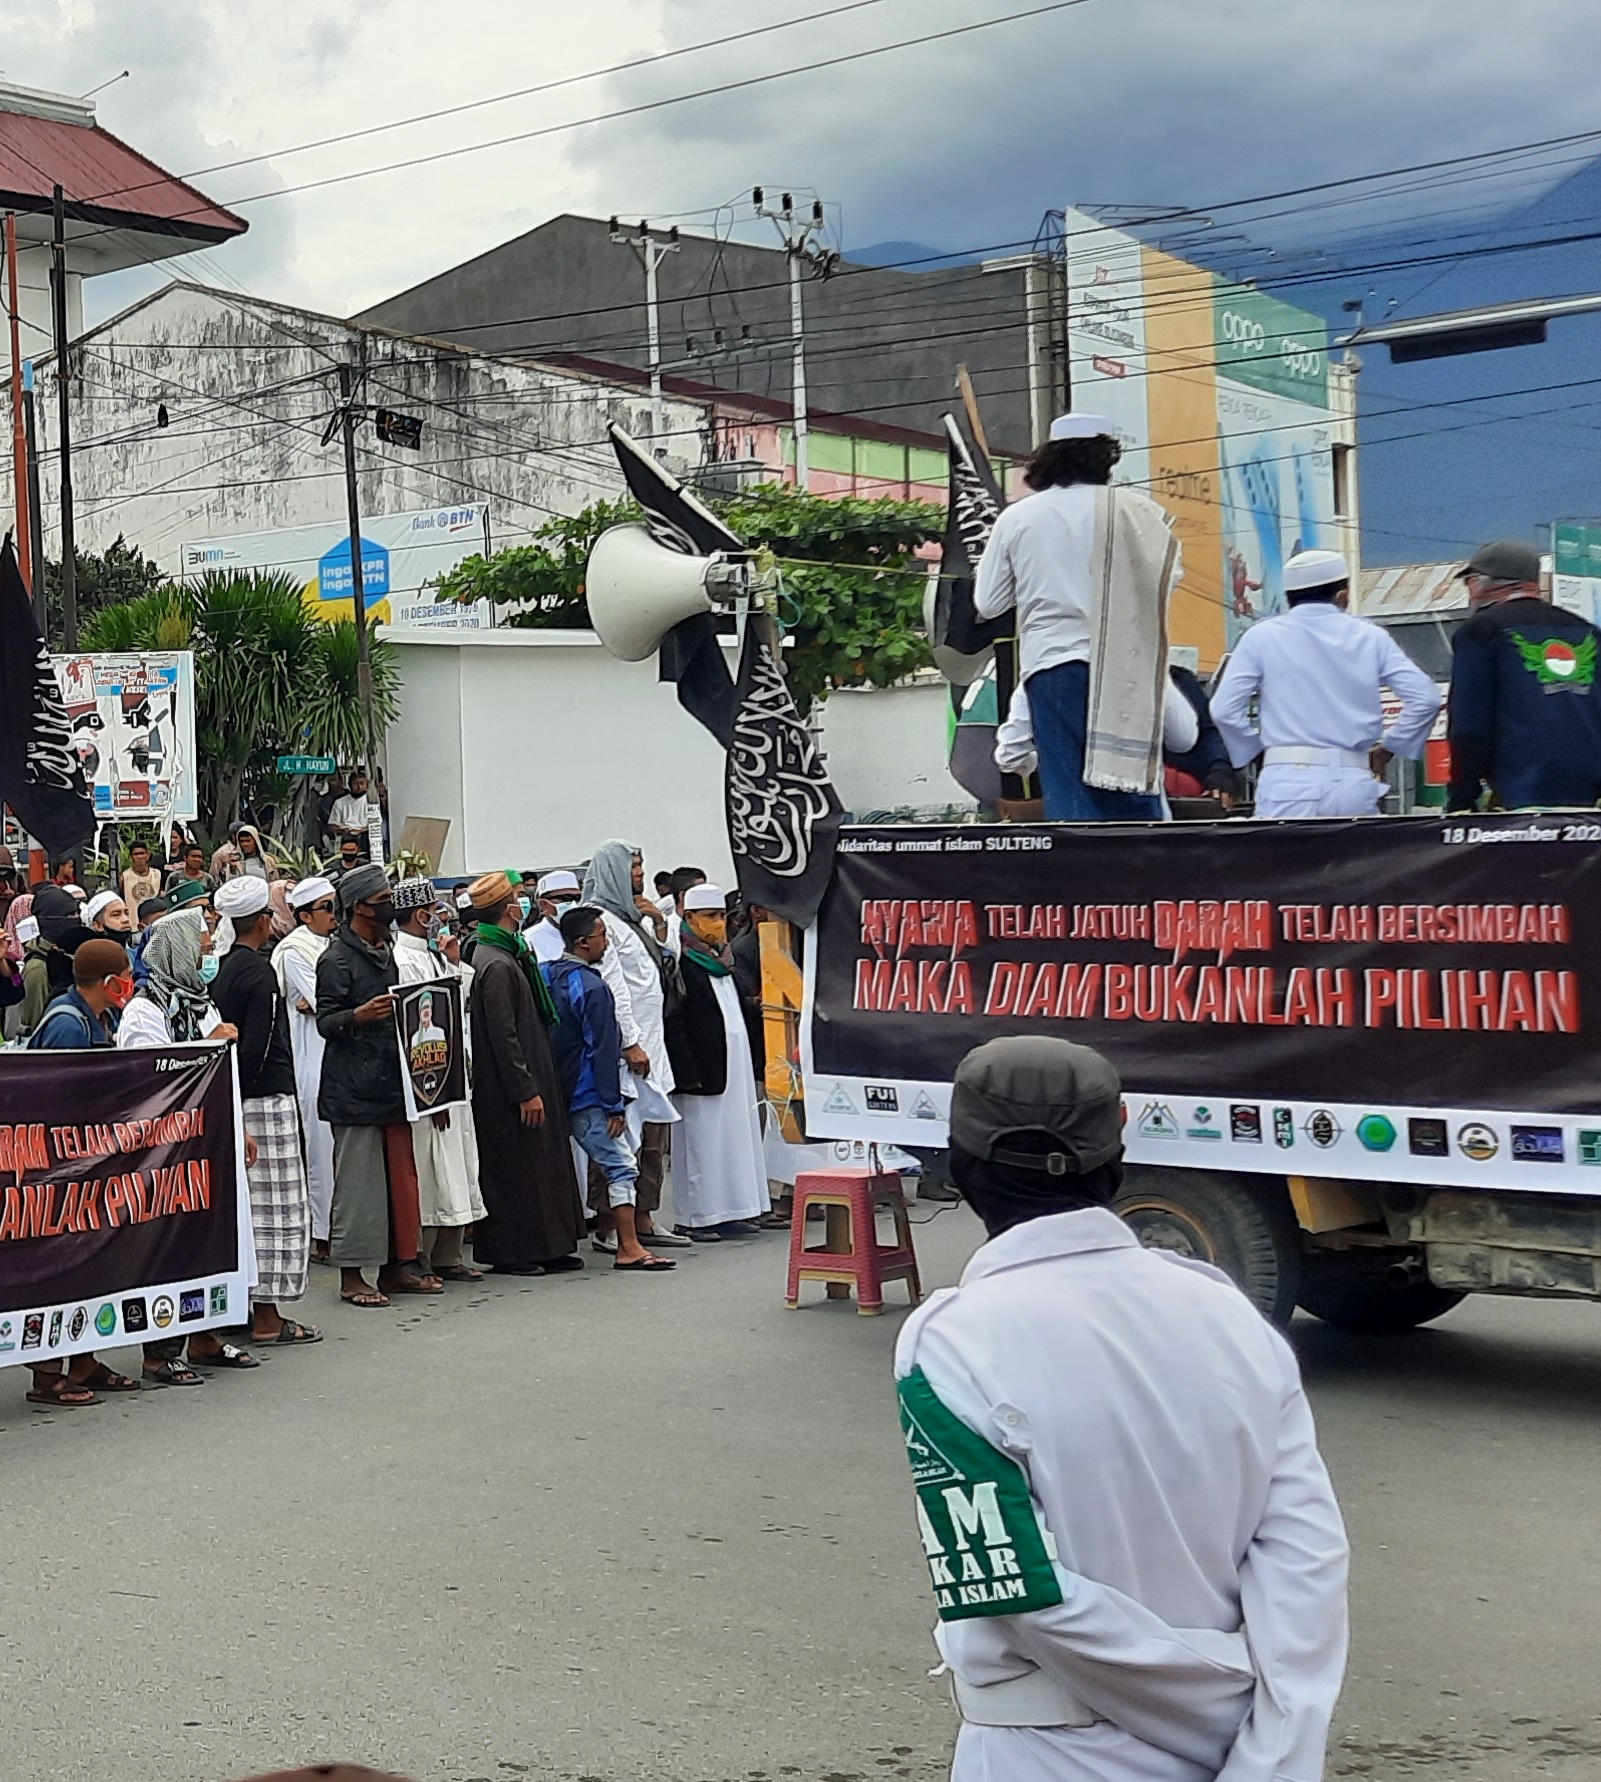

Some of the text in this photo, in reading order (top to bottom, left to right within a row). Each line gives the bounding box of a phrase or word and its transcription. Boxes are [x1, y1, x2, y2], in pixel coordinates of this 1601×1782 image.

[449, 509, 475, 525] BTN
[837, 836, 1054, 852] lidaritas ummat islam SULTENG
[1442, 825, 1601, 844] 18 Desember 202
[859, 898, 1569, 955] NYAWA TELAH JATUH DARAH TELAH BERSIMBAH
[851, 957, 1581, 1034] MAKA DIAM BUKANLAH PILIHAN
[866, 1087, 895, 1101] FUI
[50, 1124, 117, 1159] TELAH
[104, 1158, 211, 1228] PILIHAN
[959, 1577, 1028, 1606] ISLAM
